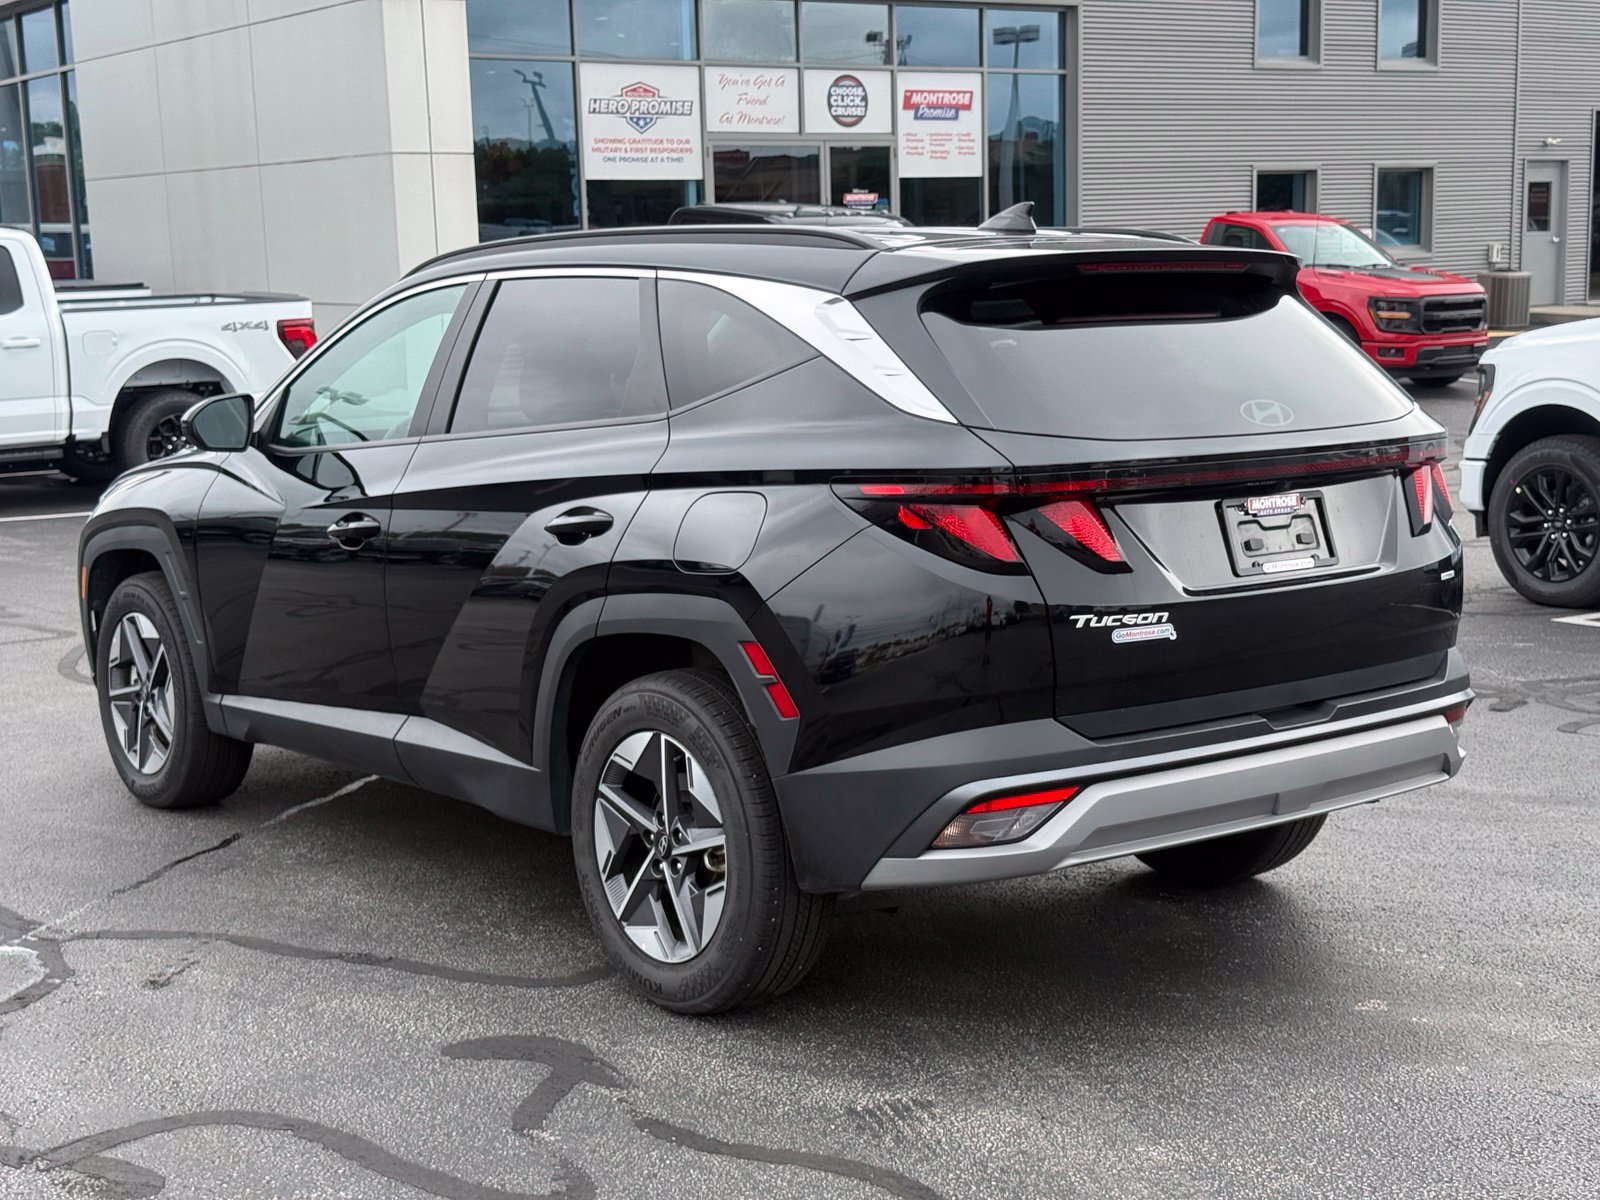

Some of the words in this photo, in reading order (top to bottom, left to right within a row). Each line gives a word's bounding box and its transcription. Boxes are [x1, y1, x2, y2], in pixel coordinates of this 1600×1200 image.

[753, 74, 773, 90] Got
[736, 92, 770, 105] Friend
[830, 95, 866, 106] CLICK.
[910, 91, 972, 105] MONTROSE
[589, 98, 628, 114] HERO
[630, 99, 693, 116] PROMISE
[830, 106, 866, 116] CRUISE!
[917, 105, 956, 119] Promise
[593, 137, 626, 145] SHOWING
[1252, 496, 1297, 510] MONTROSE
[1069, 612, 1169, 628] Tucson
[1115, 628, 1171, 639] GoMontrose.com
